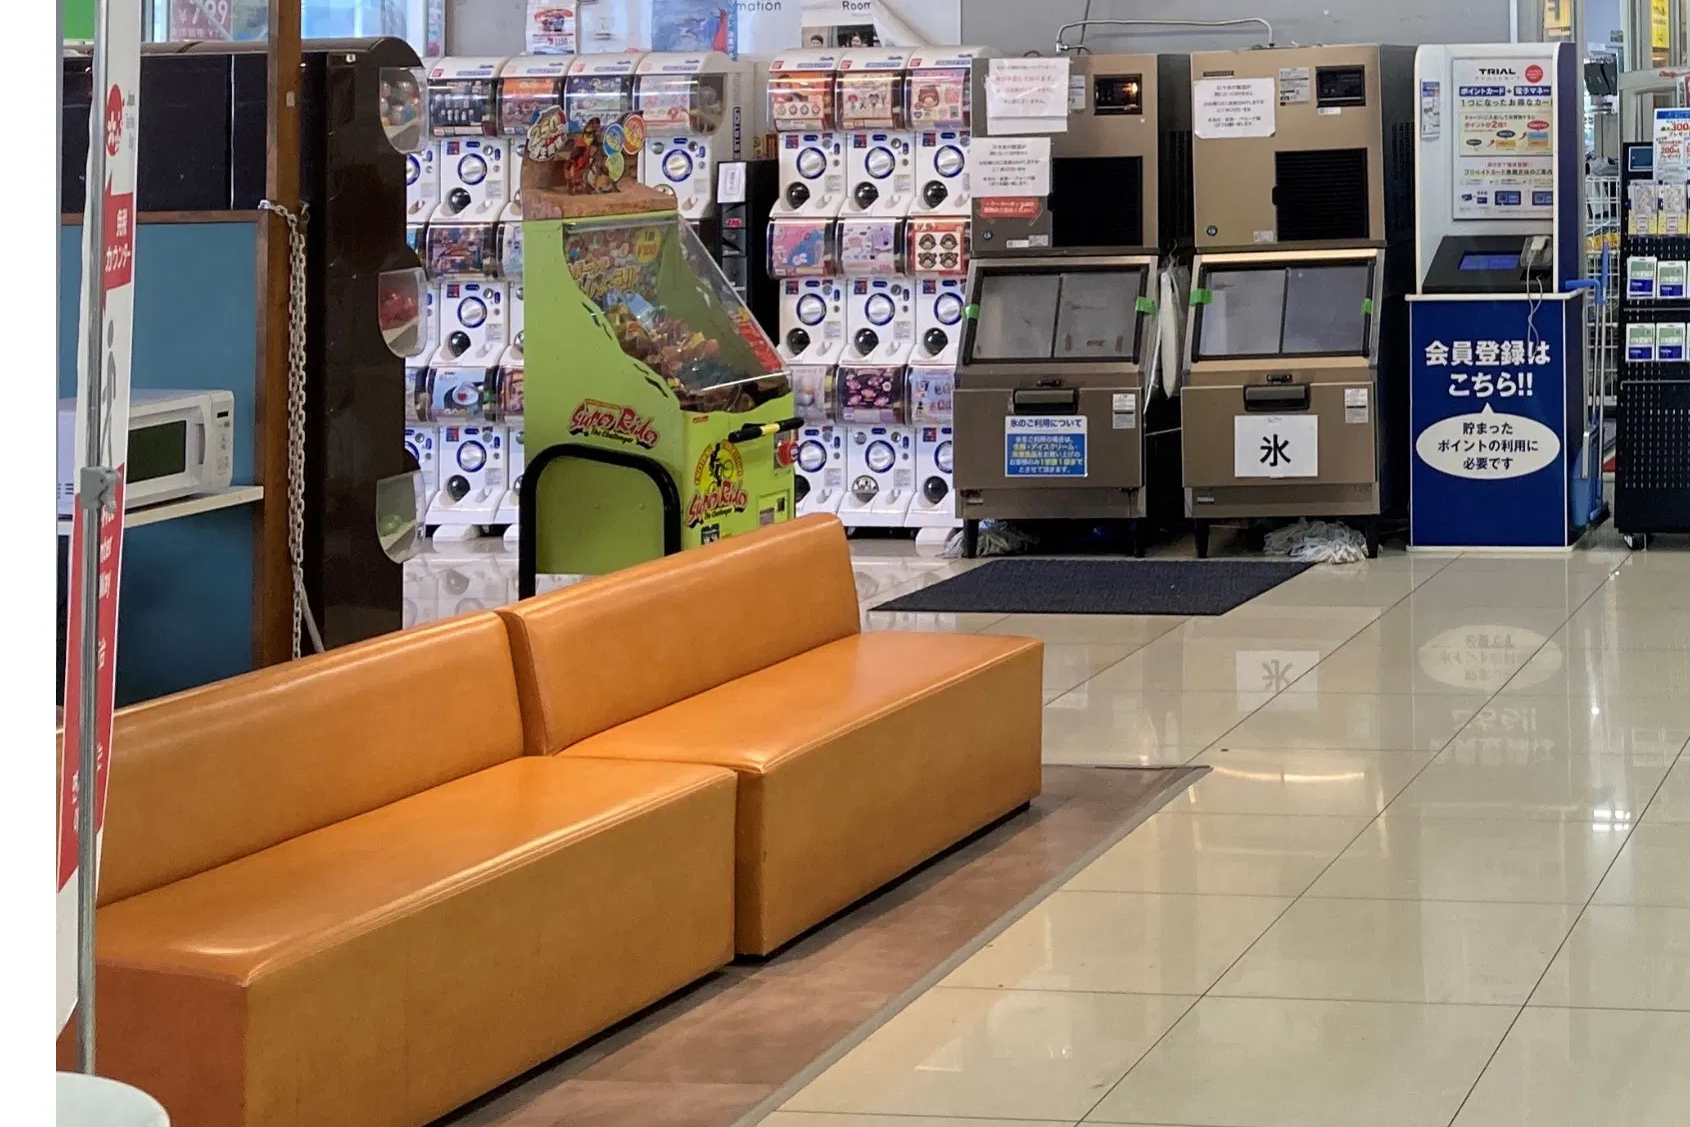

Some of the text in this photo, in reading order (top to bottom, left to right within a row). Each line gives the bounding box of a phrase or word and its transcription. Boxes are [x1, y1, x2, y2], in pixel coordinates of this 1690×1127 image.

[1460, 86, 1505, 95] ポイントカード
[1425, 340, 1550, 366] 会員登録は
[1448, 372, 1533, 397] こちら!!
[1010, 419, 1082, 428] 氷のご利用について
[1462, 422, 1513, 435] 貯まった
[1259, 433, 1292, 467] 氷
[1437, 439, 1539, 452] ポイントの利用に
[1462, 457, 1514, 470] 必要です
